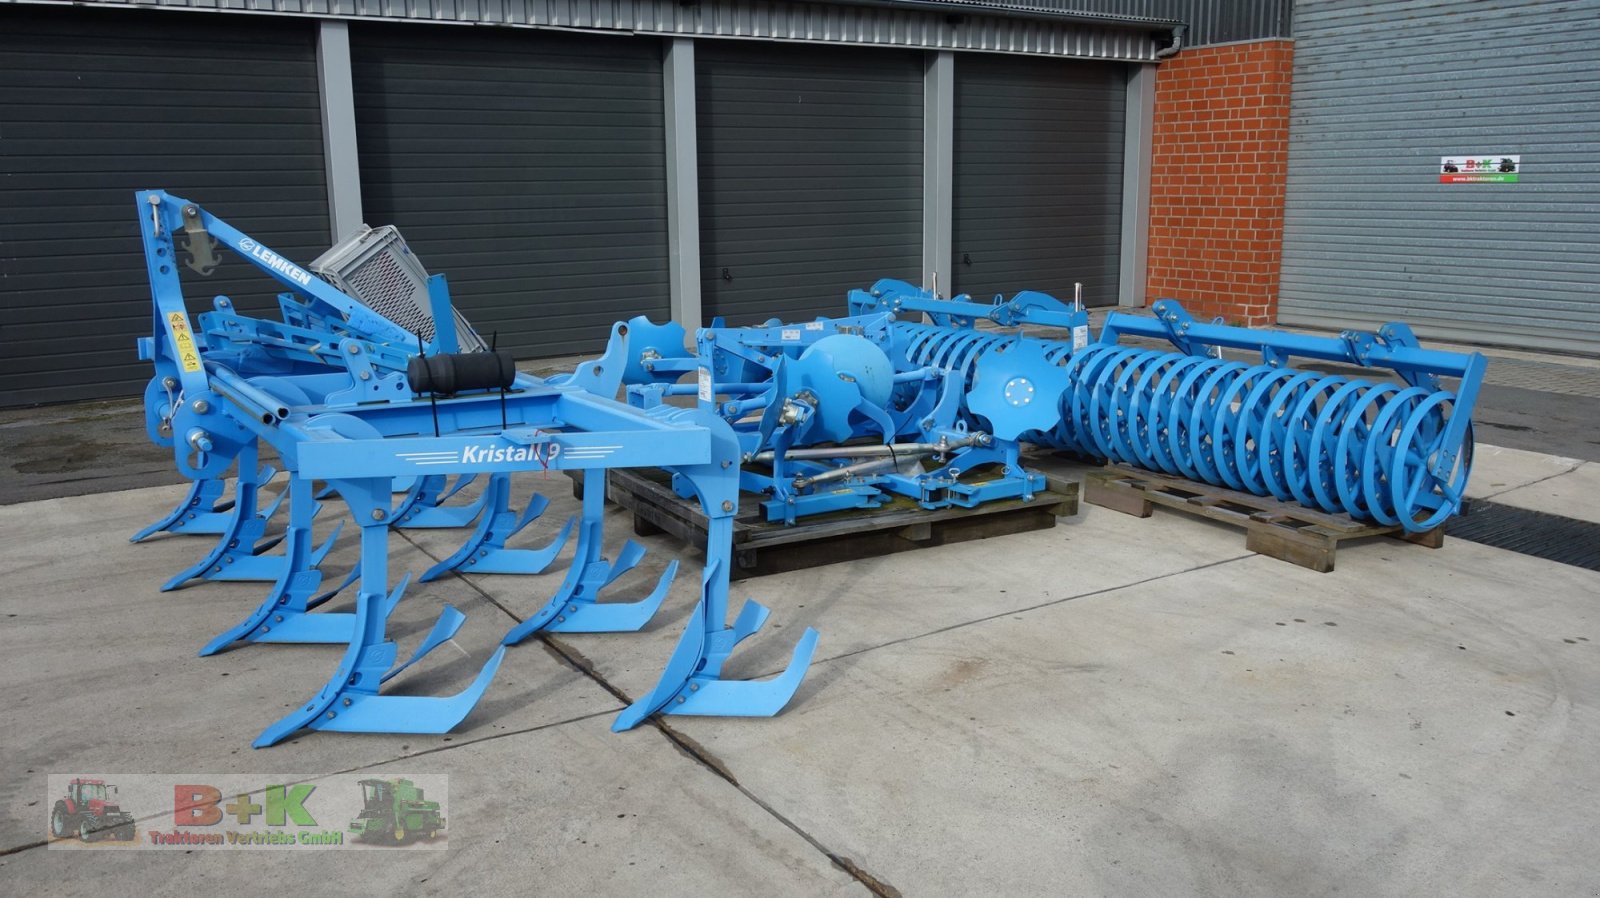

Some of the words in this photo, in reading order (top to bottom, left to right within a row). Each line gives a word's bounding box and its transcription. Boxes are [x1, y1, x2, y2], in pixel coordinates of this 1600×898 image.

[1466, 160, 1492, 168] B+K
[252, 245, 312, 286] LEMKEN
[462, 443, 542, 464] Kristall
[548, 443, 560, 460] 9
